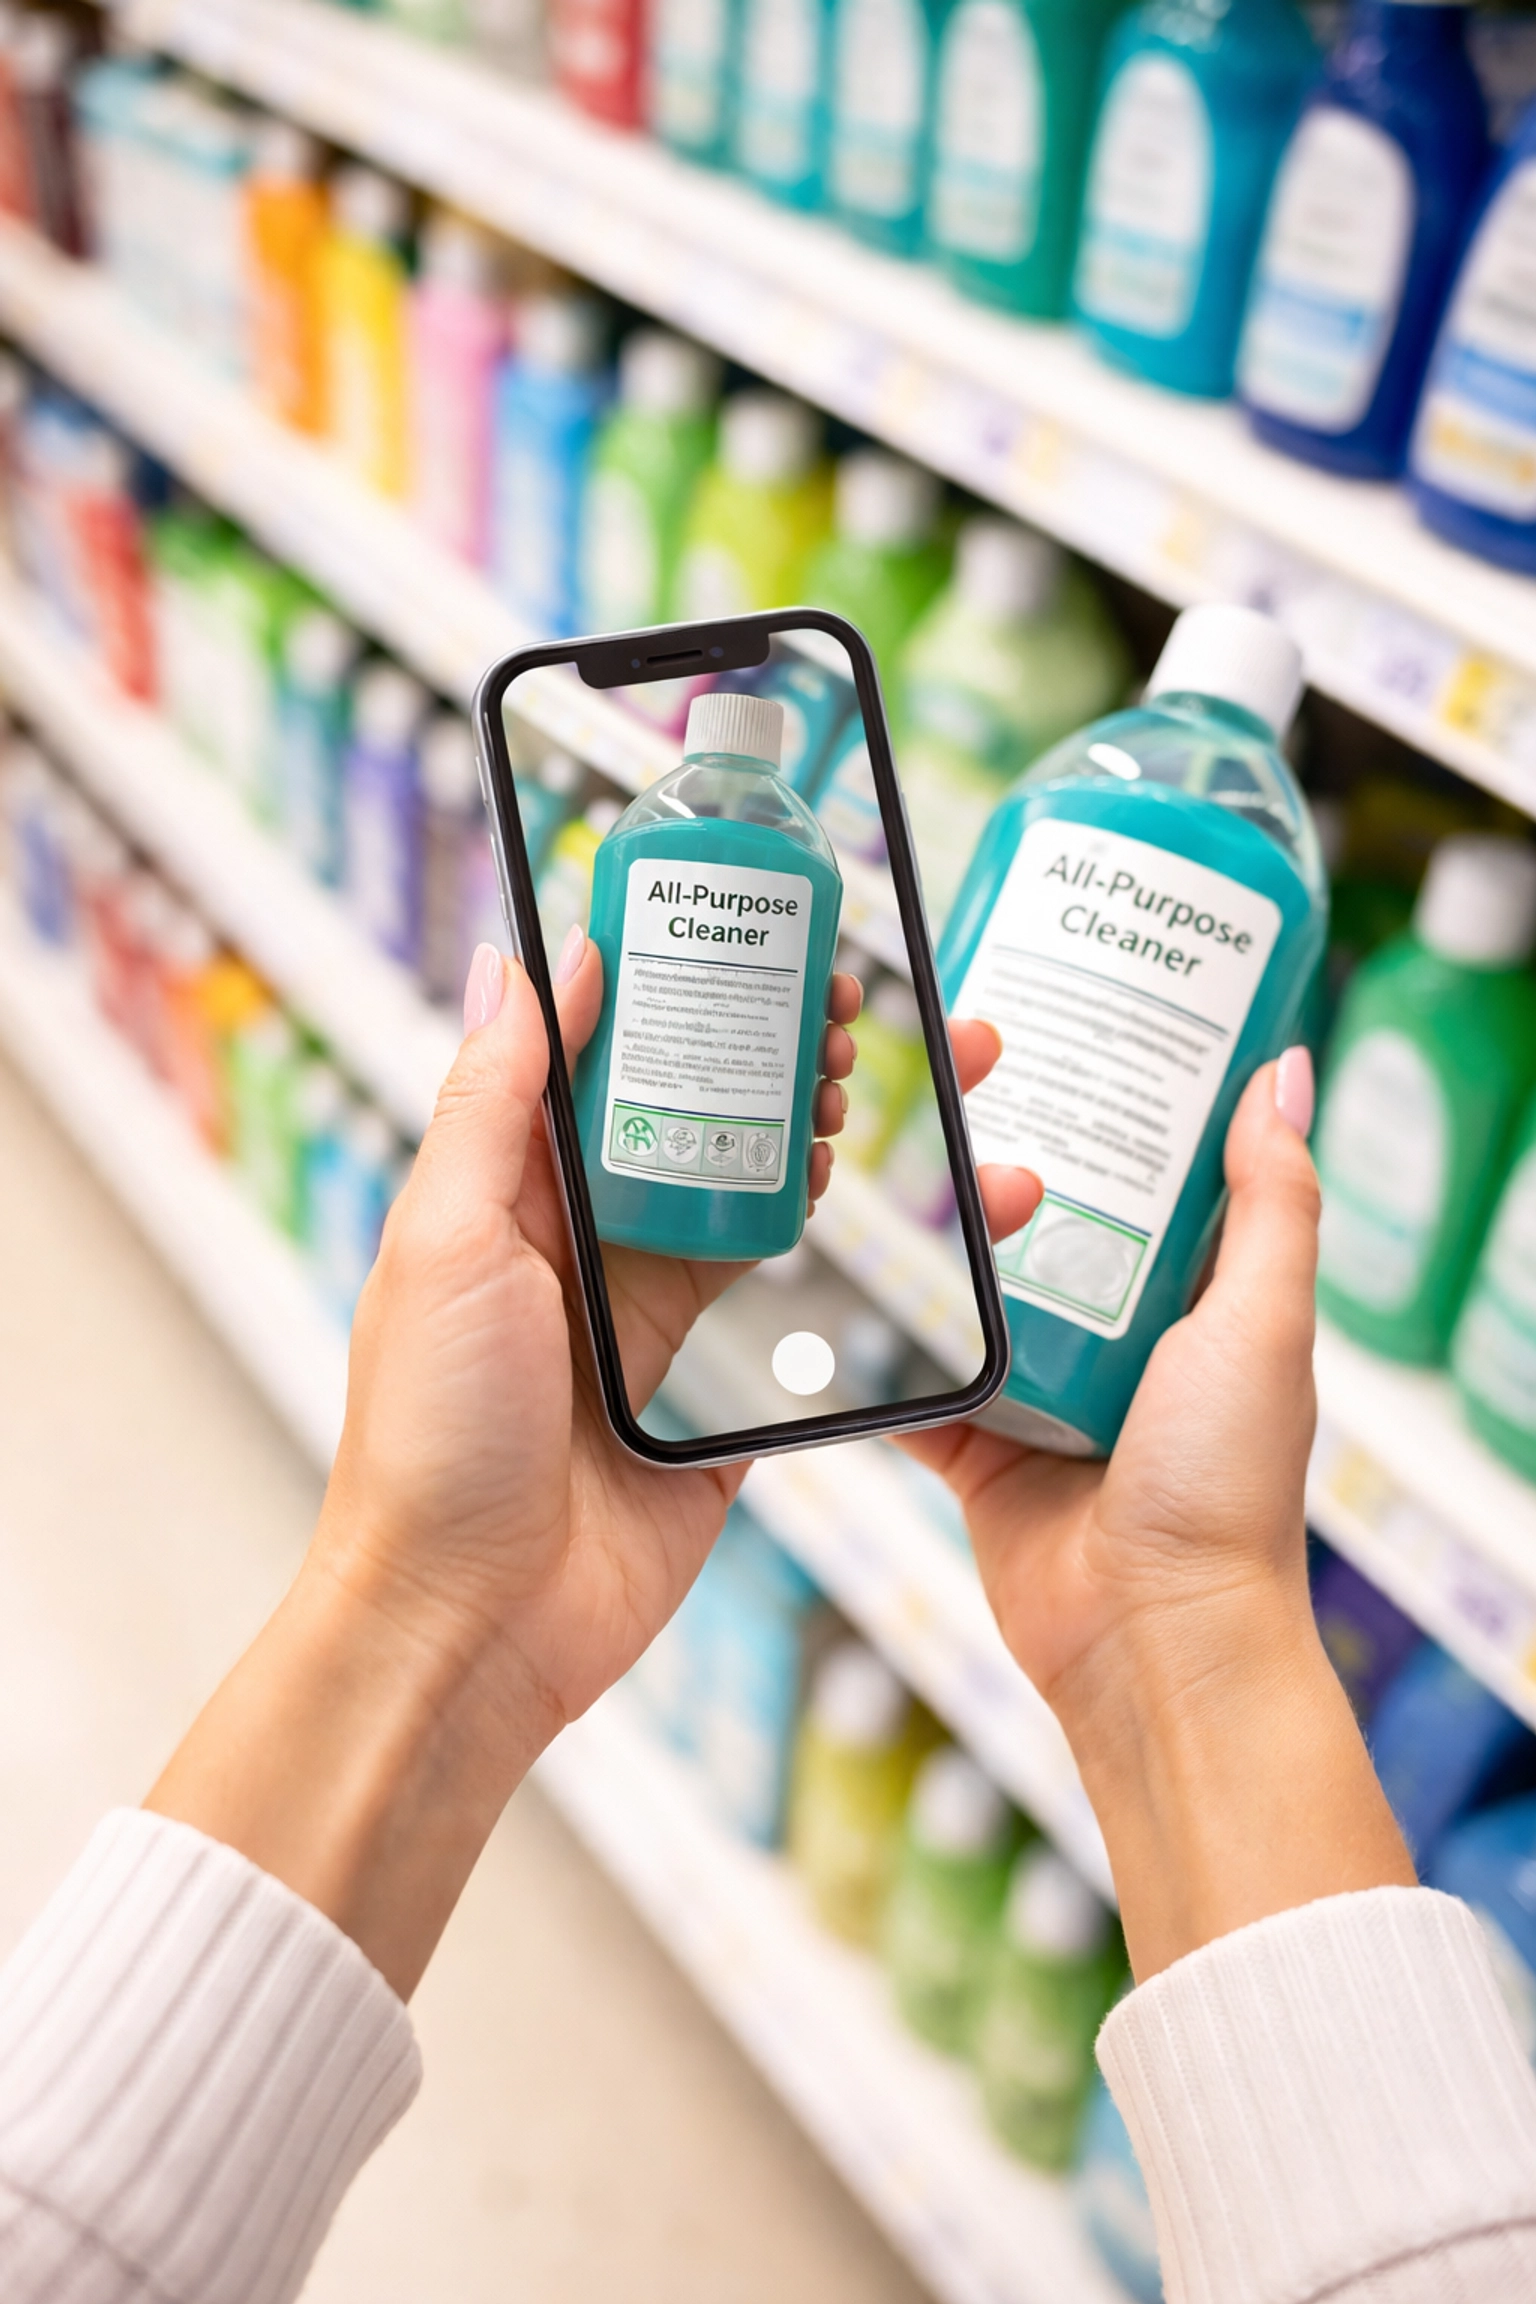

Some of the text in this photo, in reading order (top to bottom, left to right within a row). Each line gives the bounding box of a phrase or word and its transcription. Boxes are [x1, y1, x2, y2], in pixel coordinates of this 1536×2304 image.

[647, 881, 799, 917] All-Purpose
[1044, 854, 1253, 955] All-Purpose
[668, 916, 769, 947] Cleaner
[1060, 904, 1203, 978] Cleaner
